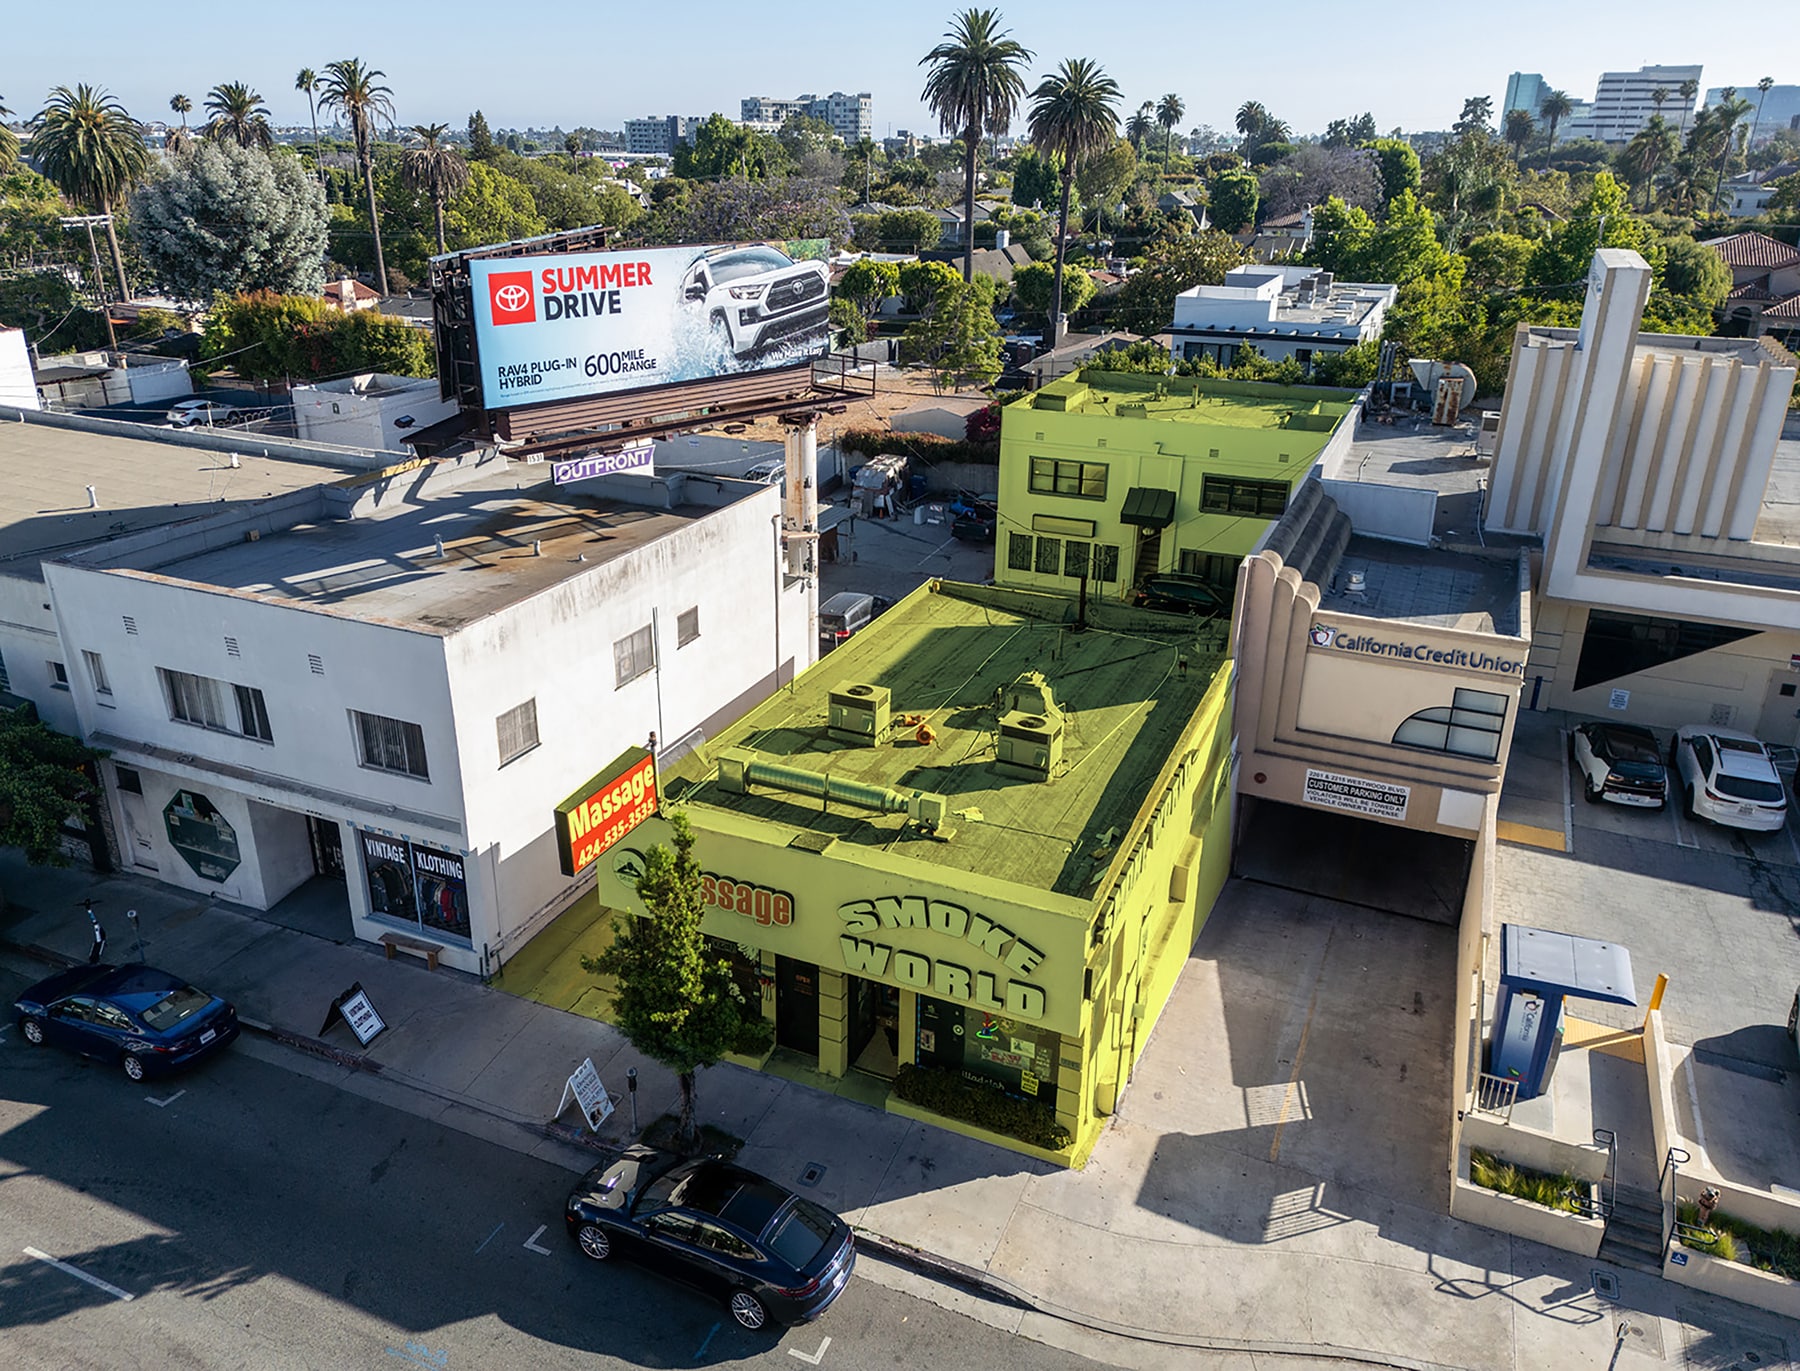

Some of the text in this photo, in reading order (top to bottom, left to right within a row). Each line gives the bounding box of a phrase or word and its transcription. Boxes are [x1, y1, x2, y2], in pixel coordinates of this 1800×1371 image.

[541, 262, 653, 295] SUMMER
[544, 290, 622, 321] DRIVE
[584, 352, 622, 377] 600
[621, 349, 645, 361] MILE
[622, 359, 657, 373] RANGE
[771, 351, 784, 360] We
[809, 346, 825, 357] Easy
[498, 357, 577, 378] RAV4 PLUG-IN
[499, 374, 543, 390] HYBRID
[558, 449, 650, 481] OUTFRONT
[1335, 634, 1524, 675] California Credit Union
[1308, 779, 1405, 805] CUSTOMER PARKING ONLY
[1347, 778, 1387, 791] WESTWOOD
[567, 764, 655, 843] Massage
[1306, 790, 1342, 800] VIOLATORS
[1371, 801, 1395, 811] TOWED
[1309, 796, 1399, 817] VEHICLE OWNER'S EXPENSE
[578, 797, 654, 866] 424-535-3535
[364, 838, 464, 880] VINTAGE KLOTHING
[700, 873, 793, 927] ssage
[837, 896, 1046, 978] SMOKE
[839, 934, 1046, 1020] WORLD
